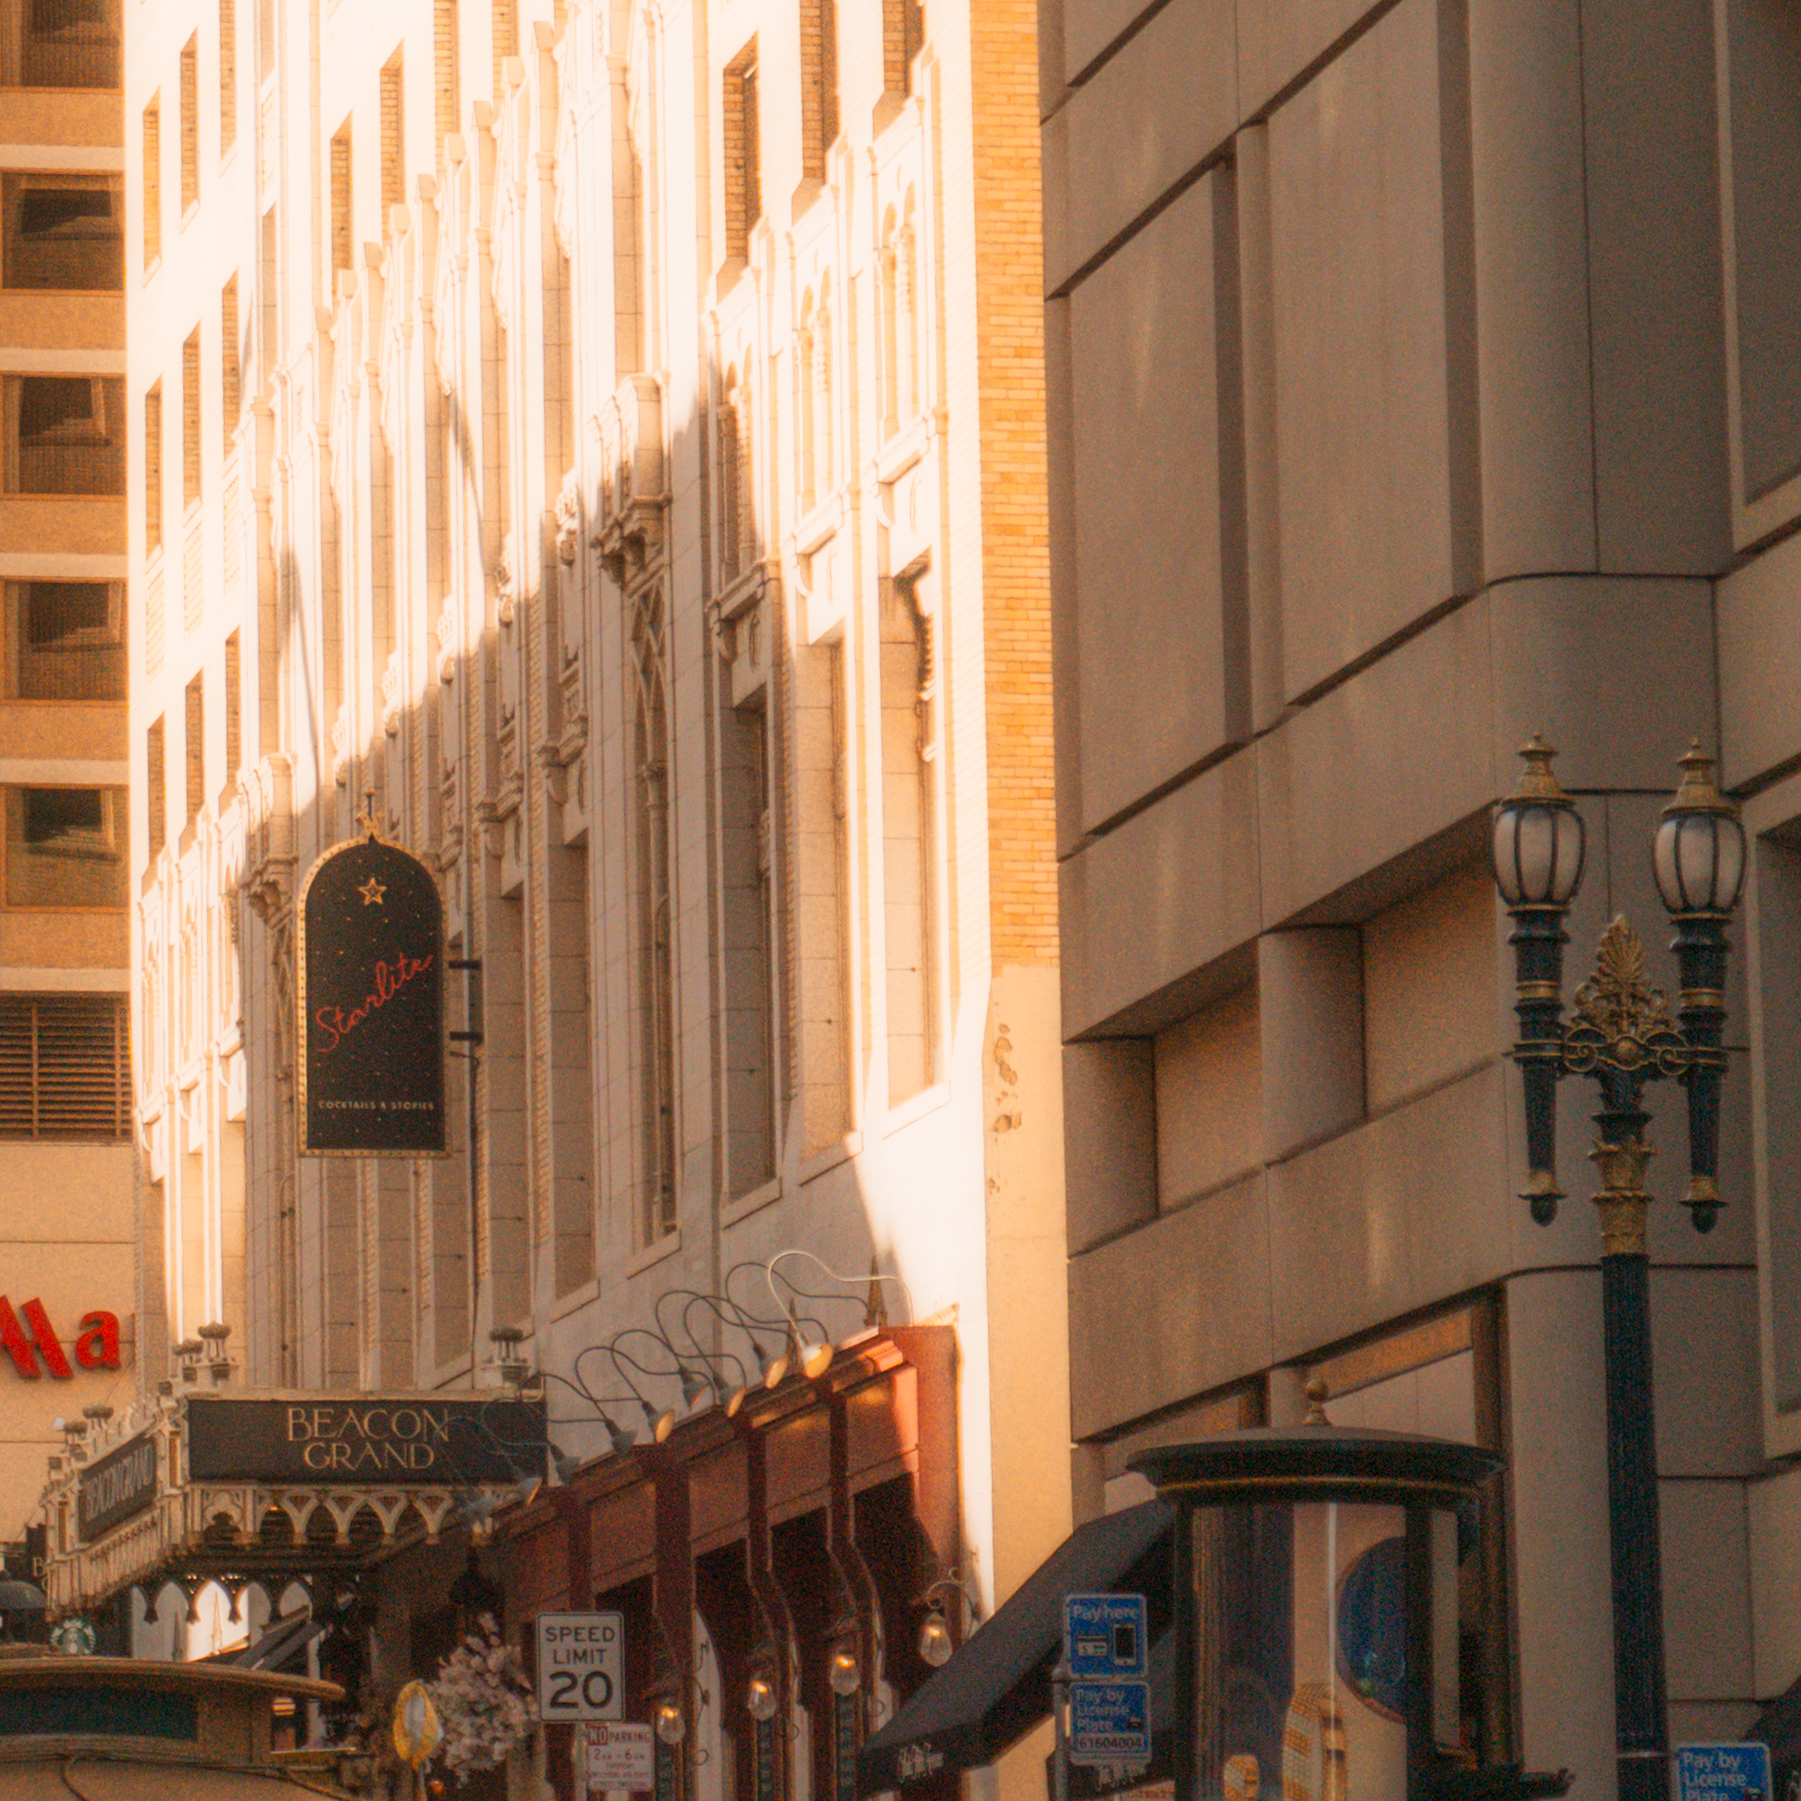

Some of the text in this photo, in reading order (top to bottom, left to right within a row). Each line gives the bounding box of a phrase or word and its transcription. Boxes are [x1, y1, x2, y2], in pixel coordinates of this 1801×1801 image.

[316, 953, 434, 1052] Starlite
[318, 1101, 376, 1110] COCKTAILS
[391, 1101, 434, 1110] STORIES
[287, 1408, 450, 1442] BEACON
[304, 1443, 435, 1470] GRAND
[1073, 1604, 1140, 1623] Pay here
[545, 1627, 615, 1642] SPEED
[553, 1649, 607, 1664] LIMIT
[549, 1671, 613, 1708] 20
[589, 1727, 651, 1744] NO PARKING
[1684, 1751, 1740, 1774] Pay by
[1685, 1772, 1747, 1787] License
